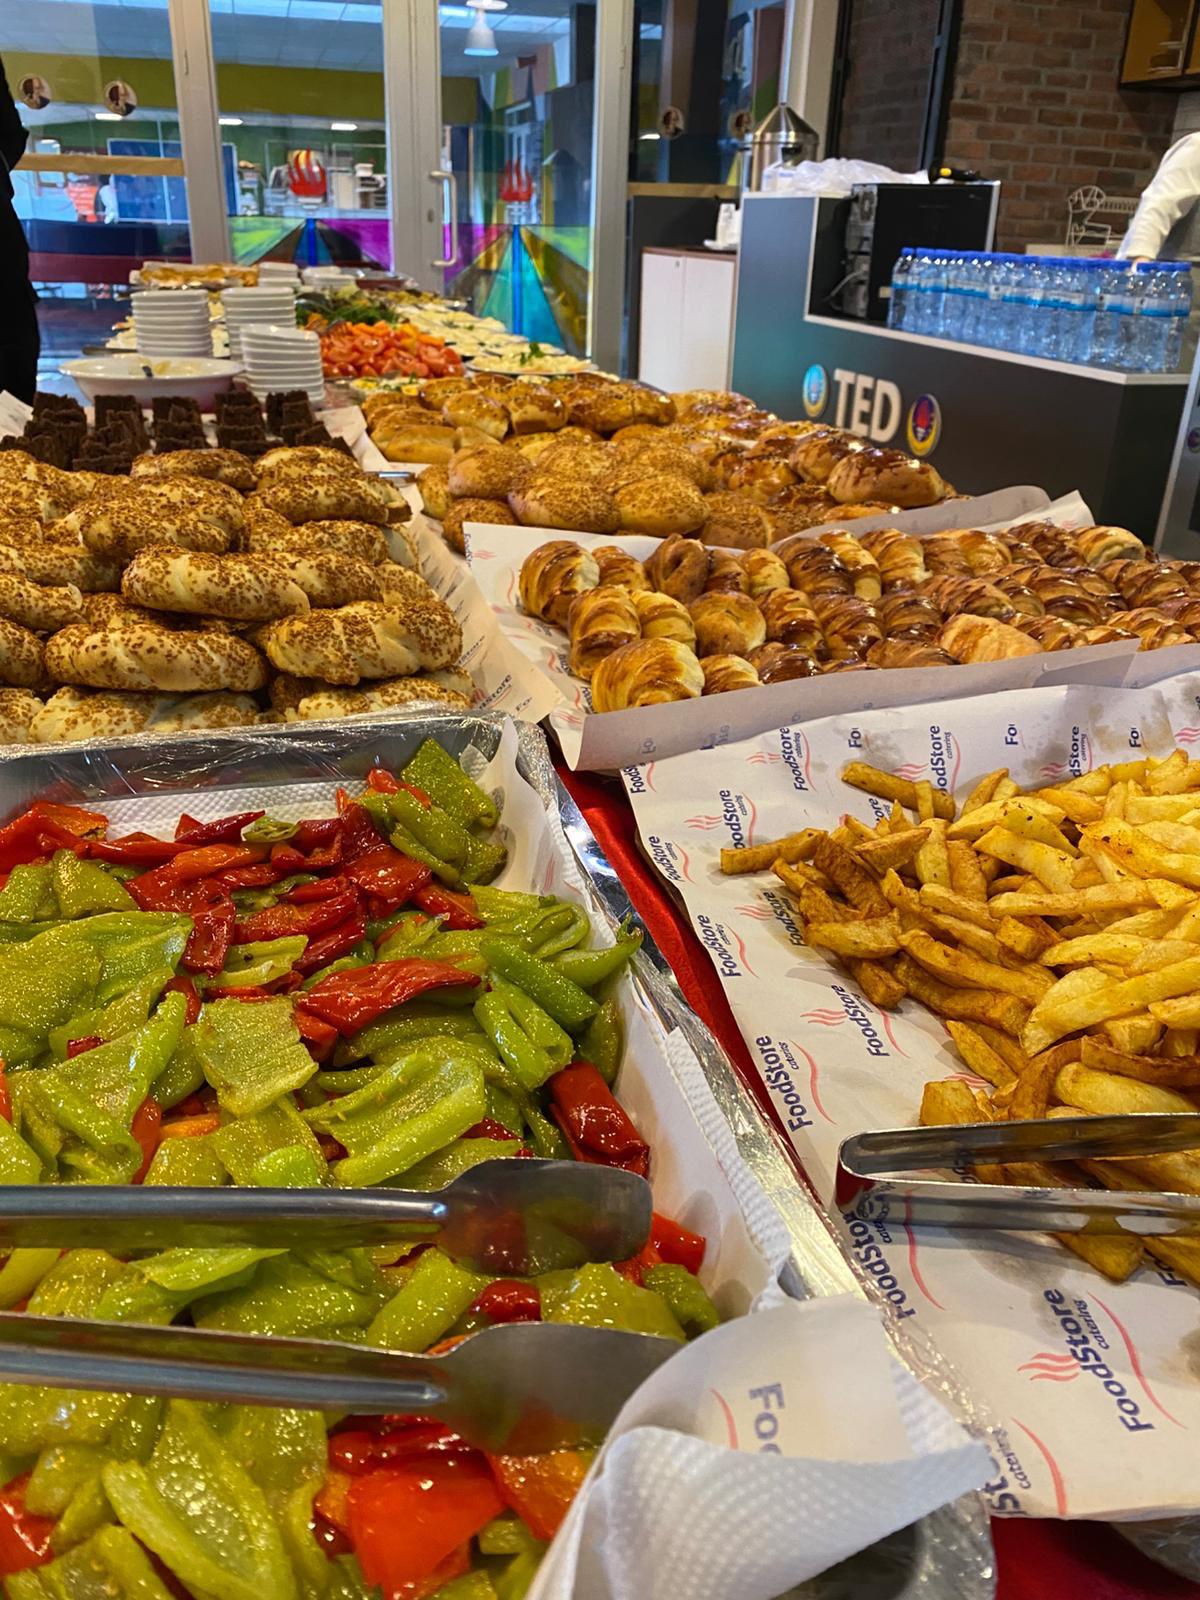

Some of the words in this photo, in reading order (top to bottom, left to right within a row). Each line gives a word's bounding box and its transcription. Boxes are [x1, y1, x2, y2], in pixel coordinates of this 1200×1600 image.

[834, 368, 902, 443] TED
[779, 727, 808, 792] FoodStore
[848, 727, 862, 748] Fo
[929, 725, 949, 795] odStore
[1004, 723, 1019, 746] Fo
[1128, 727, 1142, 748] Fo
[622, 764, 647, 794] FoodS
[697, 914, 742, 978] FoodStore
[831, 984, 890, 1057] FoodStore
[755, 1035, 814, 1133] FoodStore
[1073, 1299, 1111, 1350] catering
[1043, 1288, 1156, 1432] FoodStore
